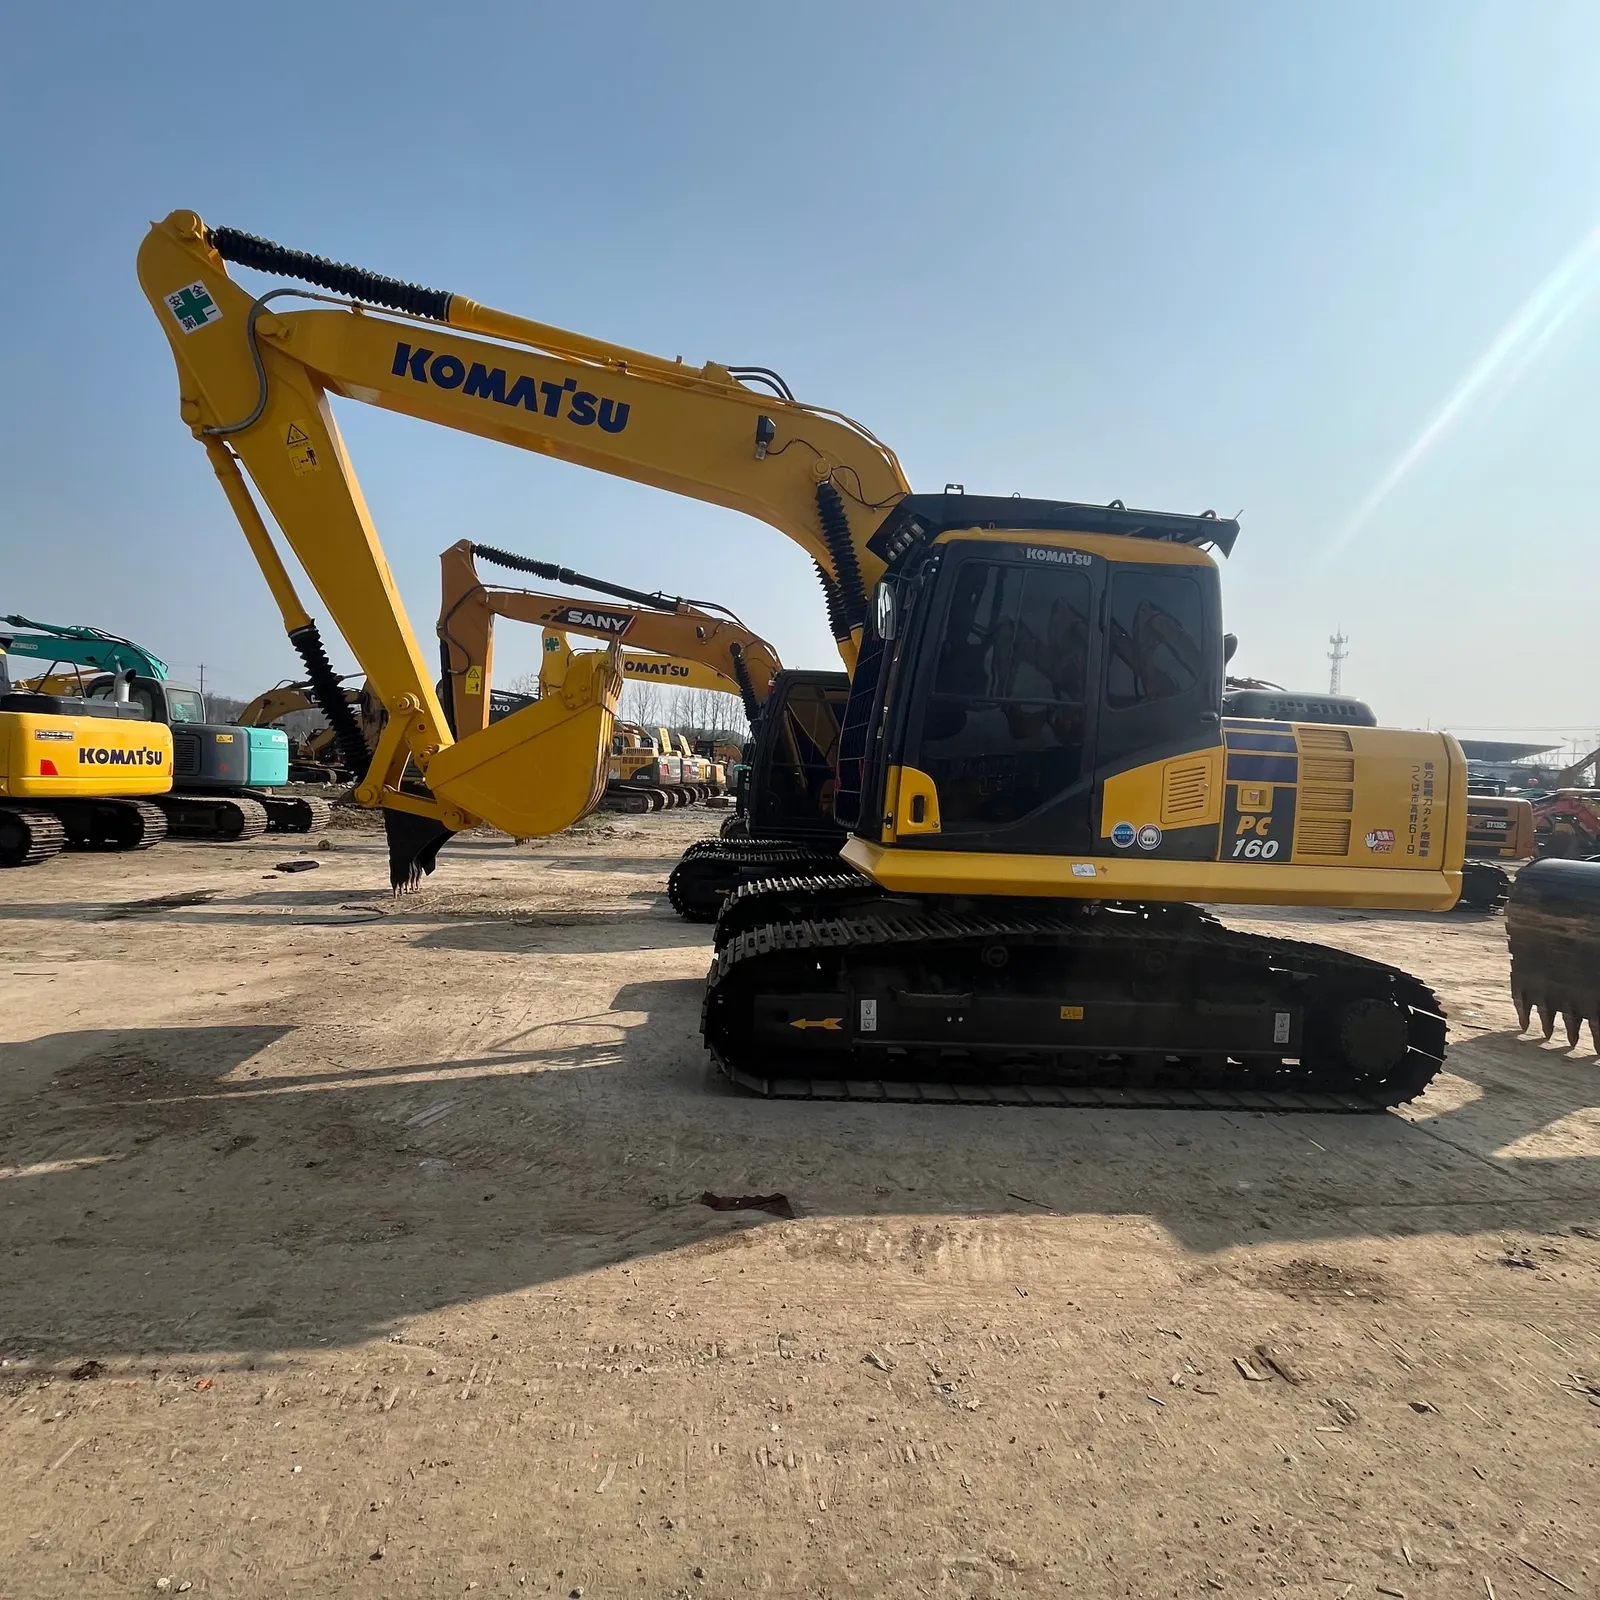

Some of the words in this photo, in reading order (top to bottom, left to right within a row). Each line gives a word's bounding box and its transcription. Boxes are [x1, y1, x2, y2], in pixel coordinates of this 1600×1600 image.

[391, 341, 631, 434] KOMATSU
[1026, 547, 1093, 566] KOMATSU
[567, 610, 626, 631] SANY
[624, 660, 690, 677] OMATSU
[490, 703, 511, 712] LVO
[79, 746, 163, 766] KOMATSU
[1235, 815, 1273, 836] PC
[1232, 838, 1279, 859] 160
